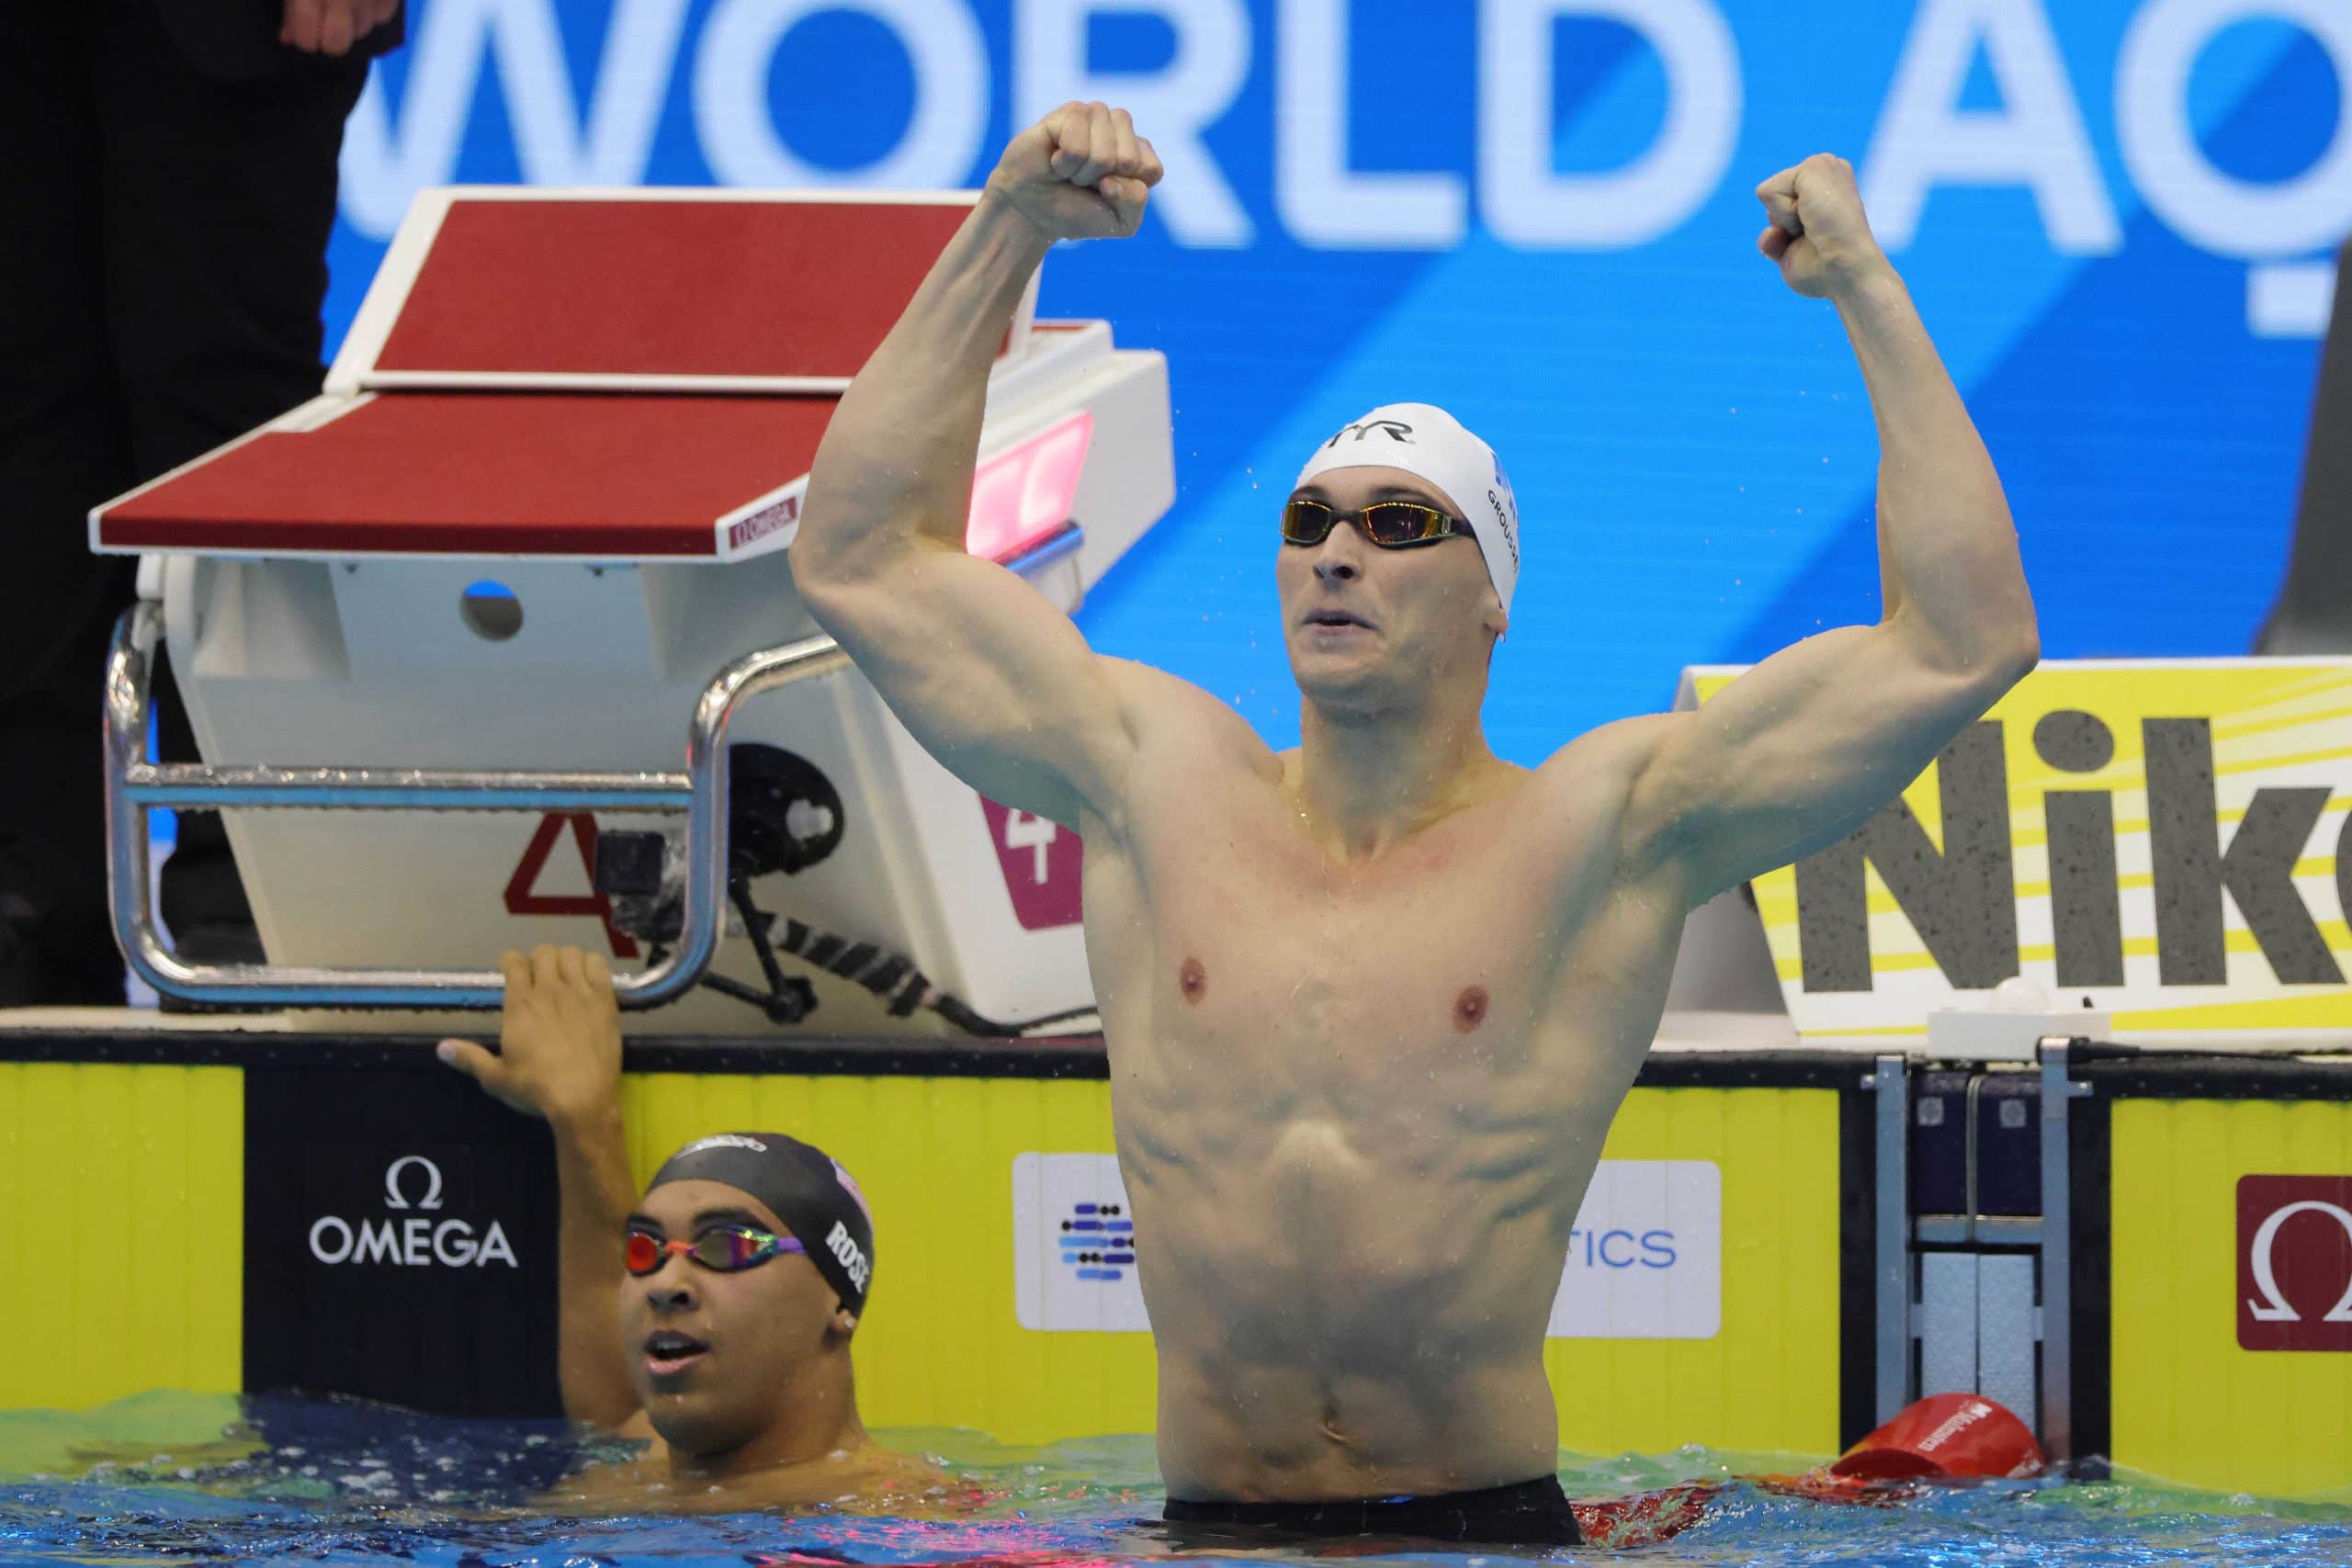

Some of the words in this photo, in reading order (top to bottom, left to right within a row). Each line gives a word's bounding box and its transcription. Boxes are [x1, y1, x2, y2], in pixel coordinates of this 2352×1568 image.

[340, 0, 1742, 251] WORLD
[1328, 421, 1413, 448] TYR
[503, 811, 639, 957] 4
[1006, 808, 1057, 884] 4
[1796, 709, 2352, 993] Nik
[309, 1215, 518, 1268] OMEGA
[1570, 1230, 1677, 1268] ICS
